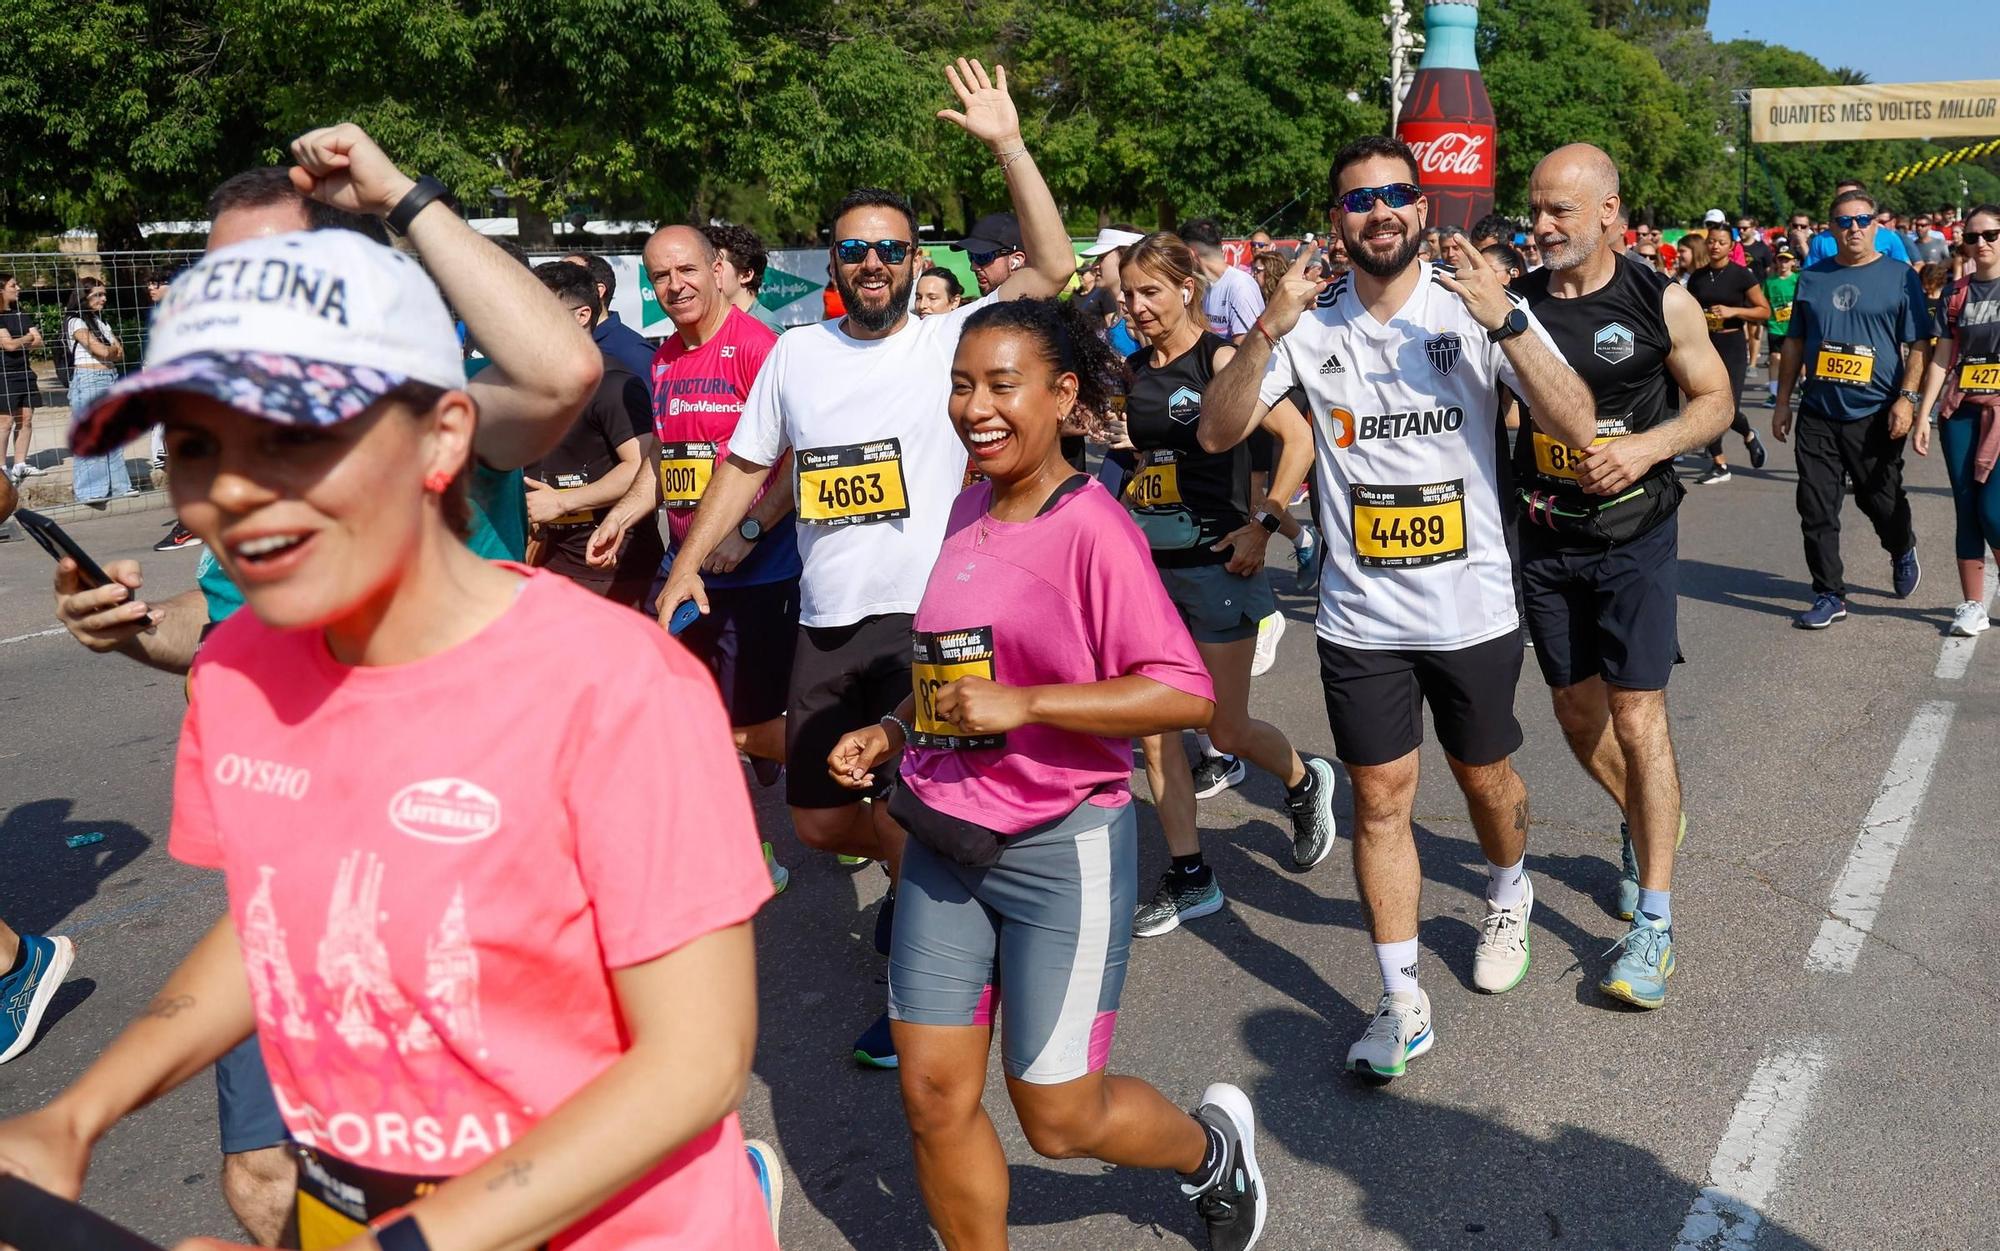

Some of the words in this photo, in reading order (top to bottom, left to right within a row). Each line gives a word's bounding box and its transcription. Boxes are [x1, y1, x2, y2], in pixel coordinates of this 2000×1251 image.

[1769, 103, 1836, 126] QUANTES
[1841, 98, 1872, 122] MÉS
[1878, 100, 1932, 121] VOLTES
[1937, 98, 1996, 119] MILLOR
[1430, 340, 1457, 350] CAM
[1319, 366, 1346, 375] adidas
[1826, 357, 1863, 377] 9522
[1971, 368, 2000, 385] 427
[1358, 406, 1464, 441] BETANO
[665, 467, 696, 493] 8001
[818, 472, 885, 510] 4663
[1360, 490, 1375, 500] Volta
[1382, 492, 1395, 501] peu
[1370, 515, 1445, 549] 4489
[214, 752, 312, 801] OYSHO
[300, 1104, 512, 1162] ORSA
